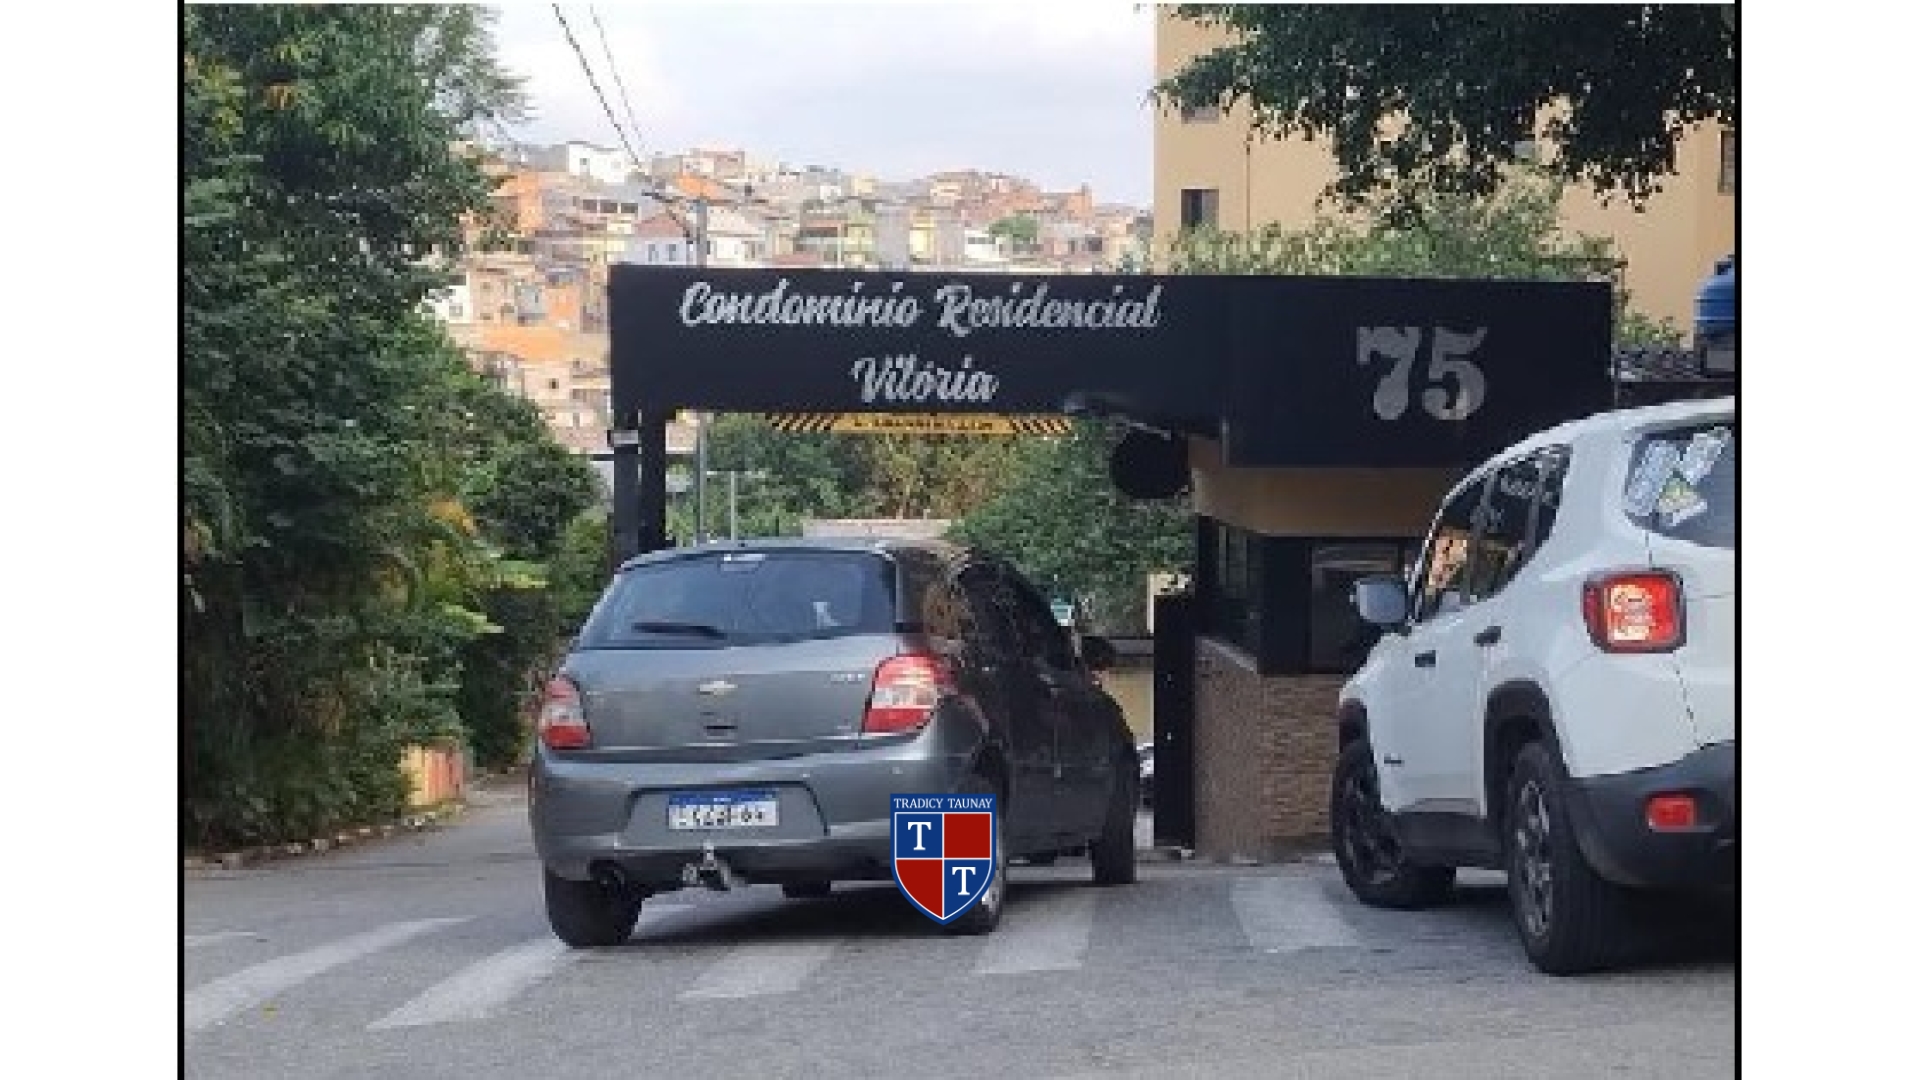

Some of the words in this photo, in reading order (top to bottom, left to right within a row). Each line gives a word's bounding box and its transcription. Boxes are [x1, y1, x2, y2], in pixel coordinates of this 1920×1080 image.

[934, 282, 1163, 337] Residencial
[848, 354, 999, 402] Vitória
[1356, 326, 1487, 420] 75
